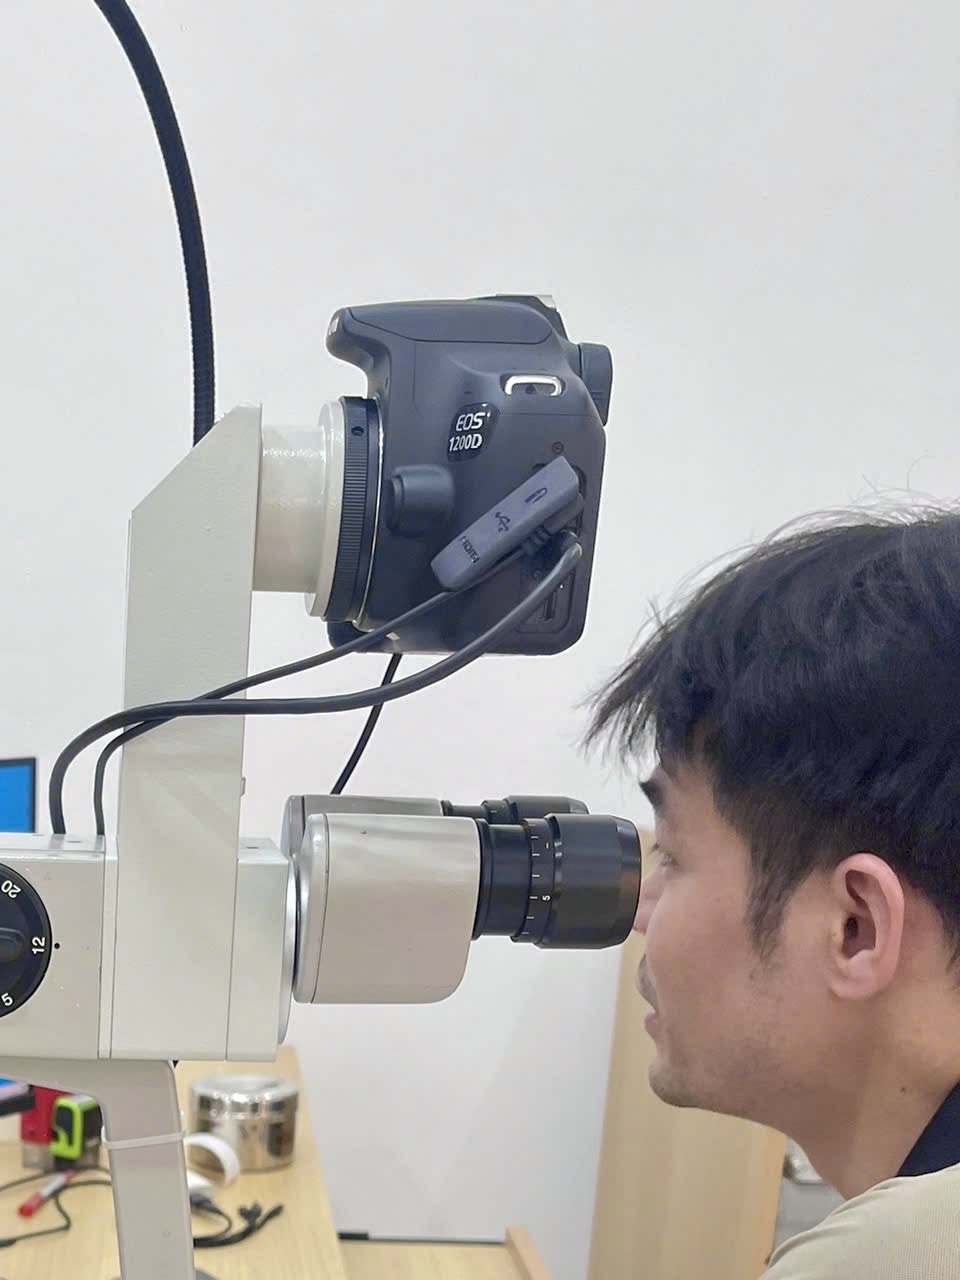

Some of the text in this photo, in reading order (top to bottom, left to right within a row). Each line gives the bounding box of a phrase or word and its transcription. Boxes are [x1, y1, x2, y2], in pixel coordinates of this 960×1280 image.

[456, 412, 485, 431] EOS
[449, 433, 483, 451] 1200D
[1, 880, 21, 898] 20
[32, 936, 46, 955] 12
[1, 992, 13, 1006] 5
